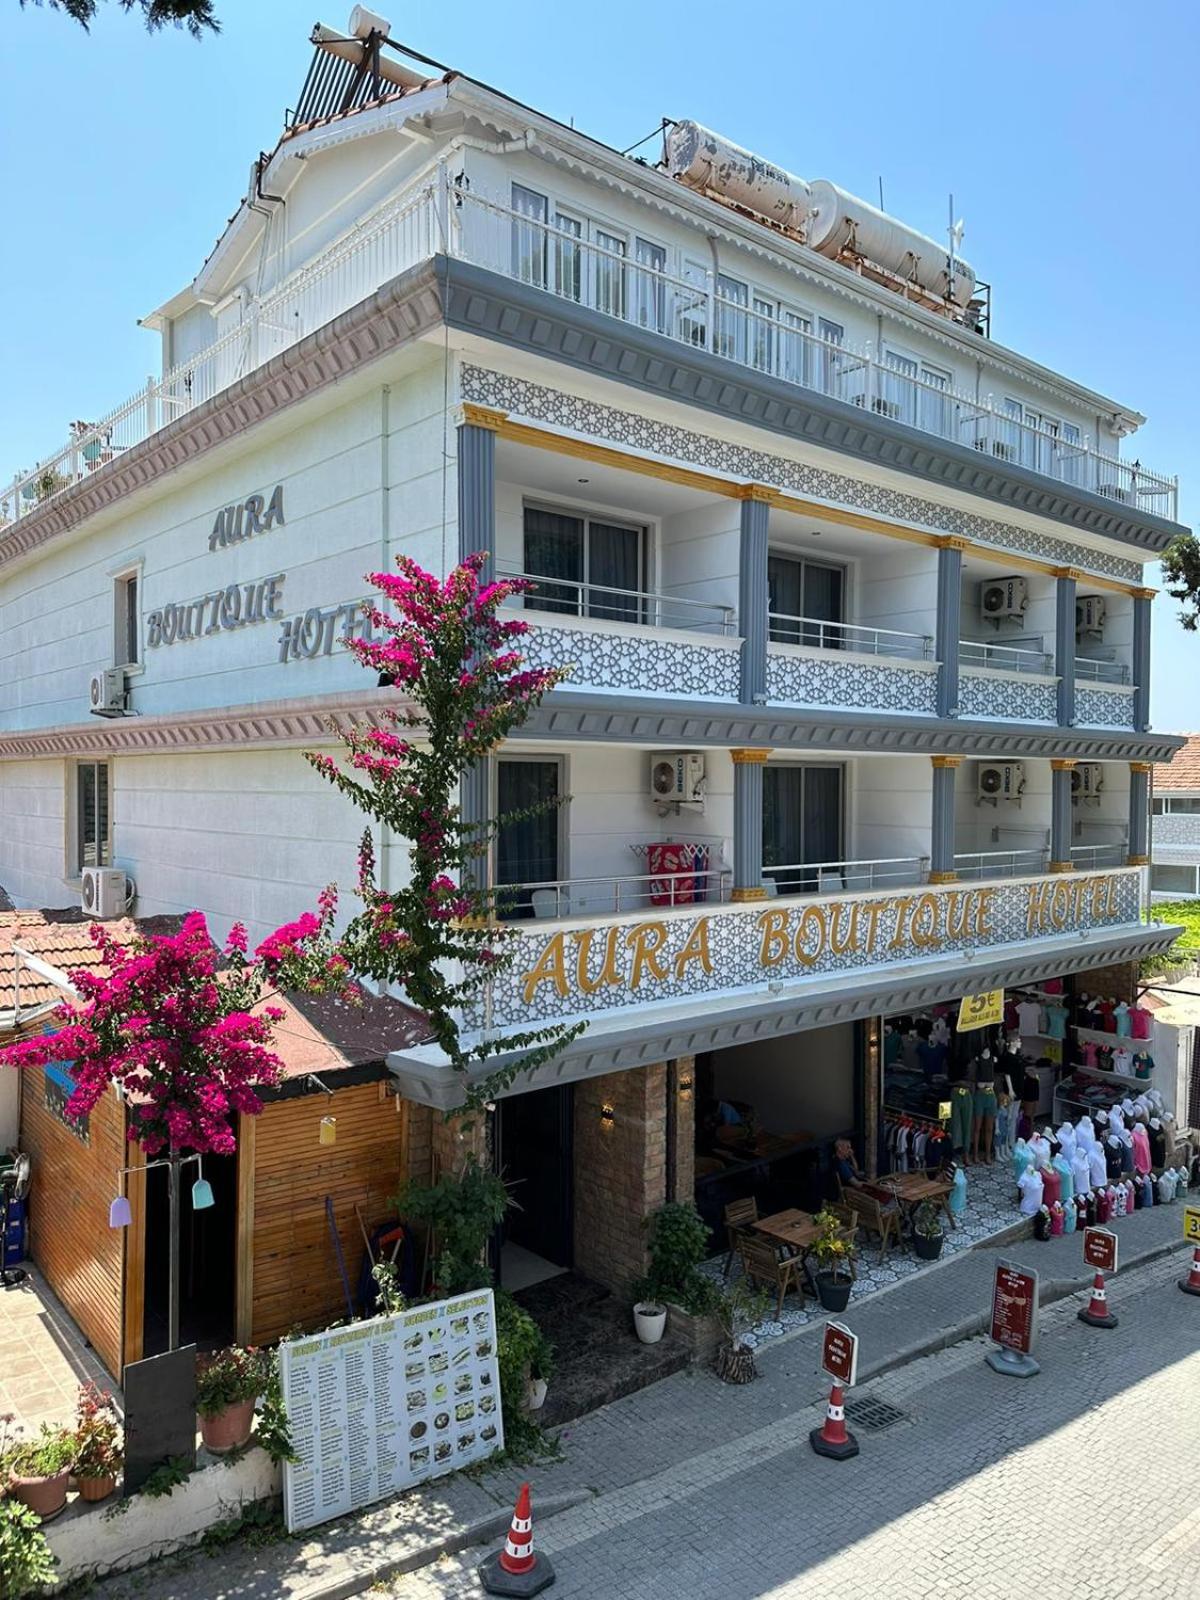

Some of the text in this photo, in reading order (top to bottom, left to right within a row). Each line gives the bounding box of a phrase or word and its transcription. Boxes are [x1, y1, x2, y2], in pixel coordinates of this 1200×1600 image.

[208, 485, 285, 551] AURA
[147, 574, 286, 649] BOUTIQUE
[521, 876, 1119, 1004] AURA BOUTIQUE HOTEL
